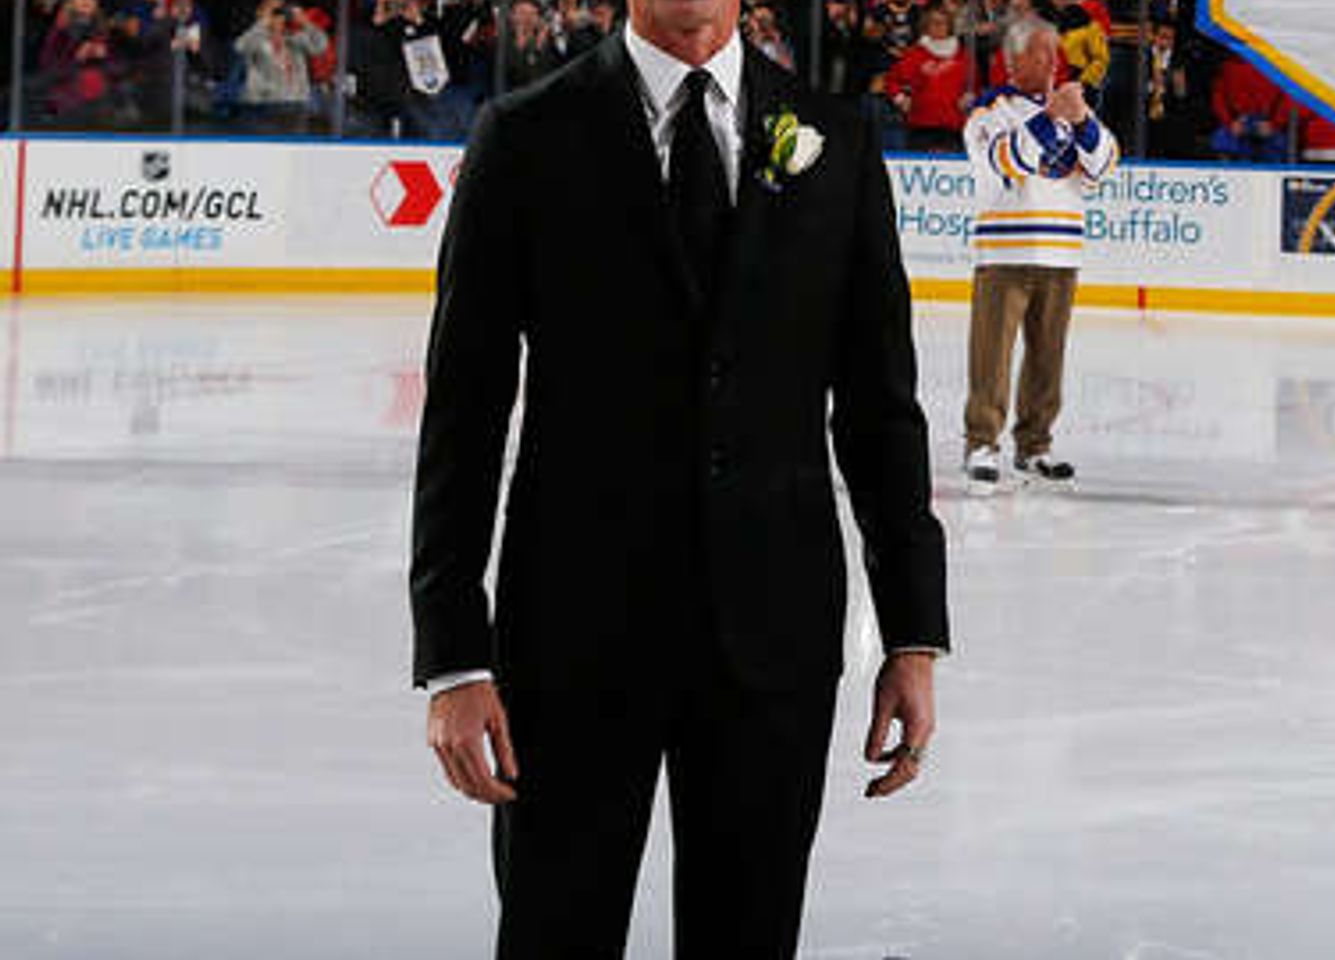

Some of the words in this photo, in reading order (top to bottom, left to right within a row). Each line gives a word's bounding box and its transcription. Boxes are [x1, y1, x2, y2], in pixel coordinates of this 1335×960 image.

[43, 186, 264, 221] NHL.COM/GCL
[82, 226, 133, 251] LIVE
[141, 226, 222, 252] GAMES
[899, 207, 975, 246] Hosp
[1084, 208, 1202, 243] Buffalo
